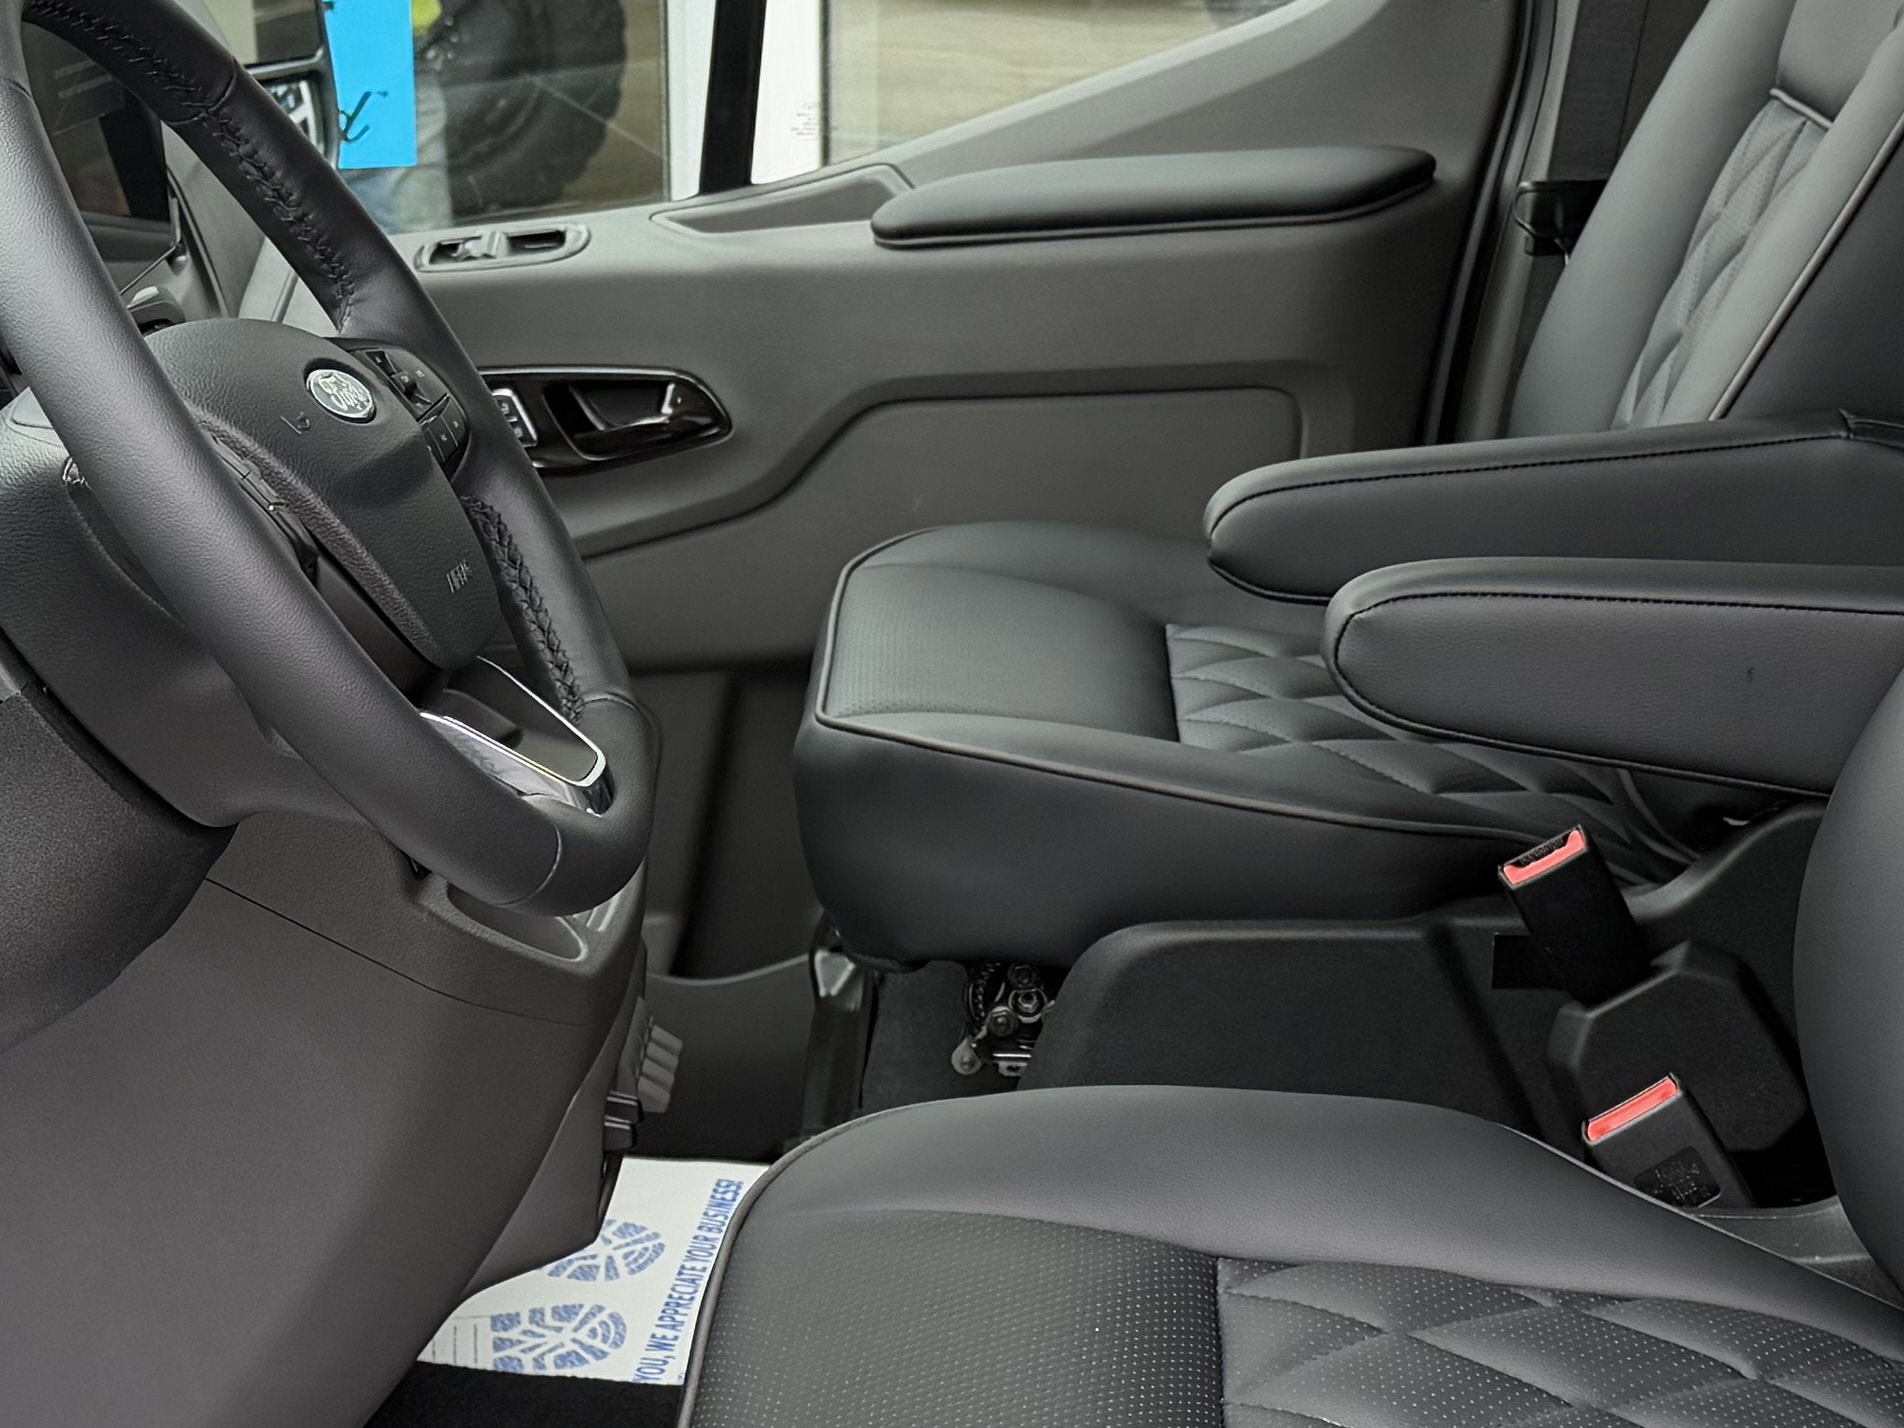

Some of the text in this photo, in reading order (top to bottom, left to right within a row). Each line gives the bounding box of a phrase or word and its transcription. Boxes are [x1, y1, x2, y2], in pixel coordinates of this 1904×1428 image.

[698, 1178, 744, 1234] BUSINESS!
[684, 1234, 718, 1264] YOUR
[655, 1263, 707, 1333] APPRECIATE
[645, 1332, 680, 1353] WE
